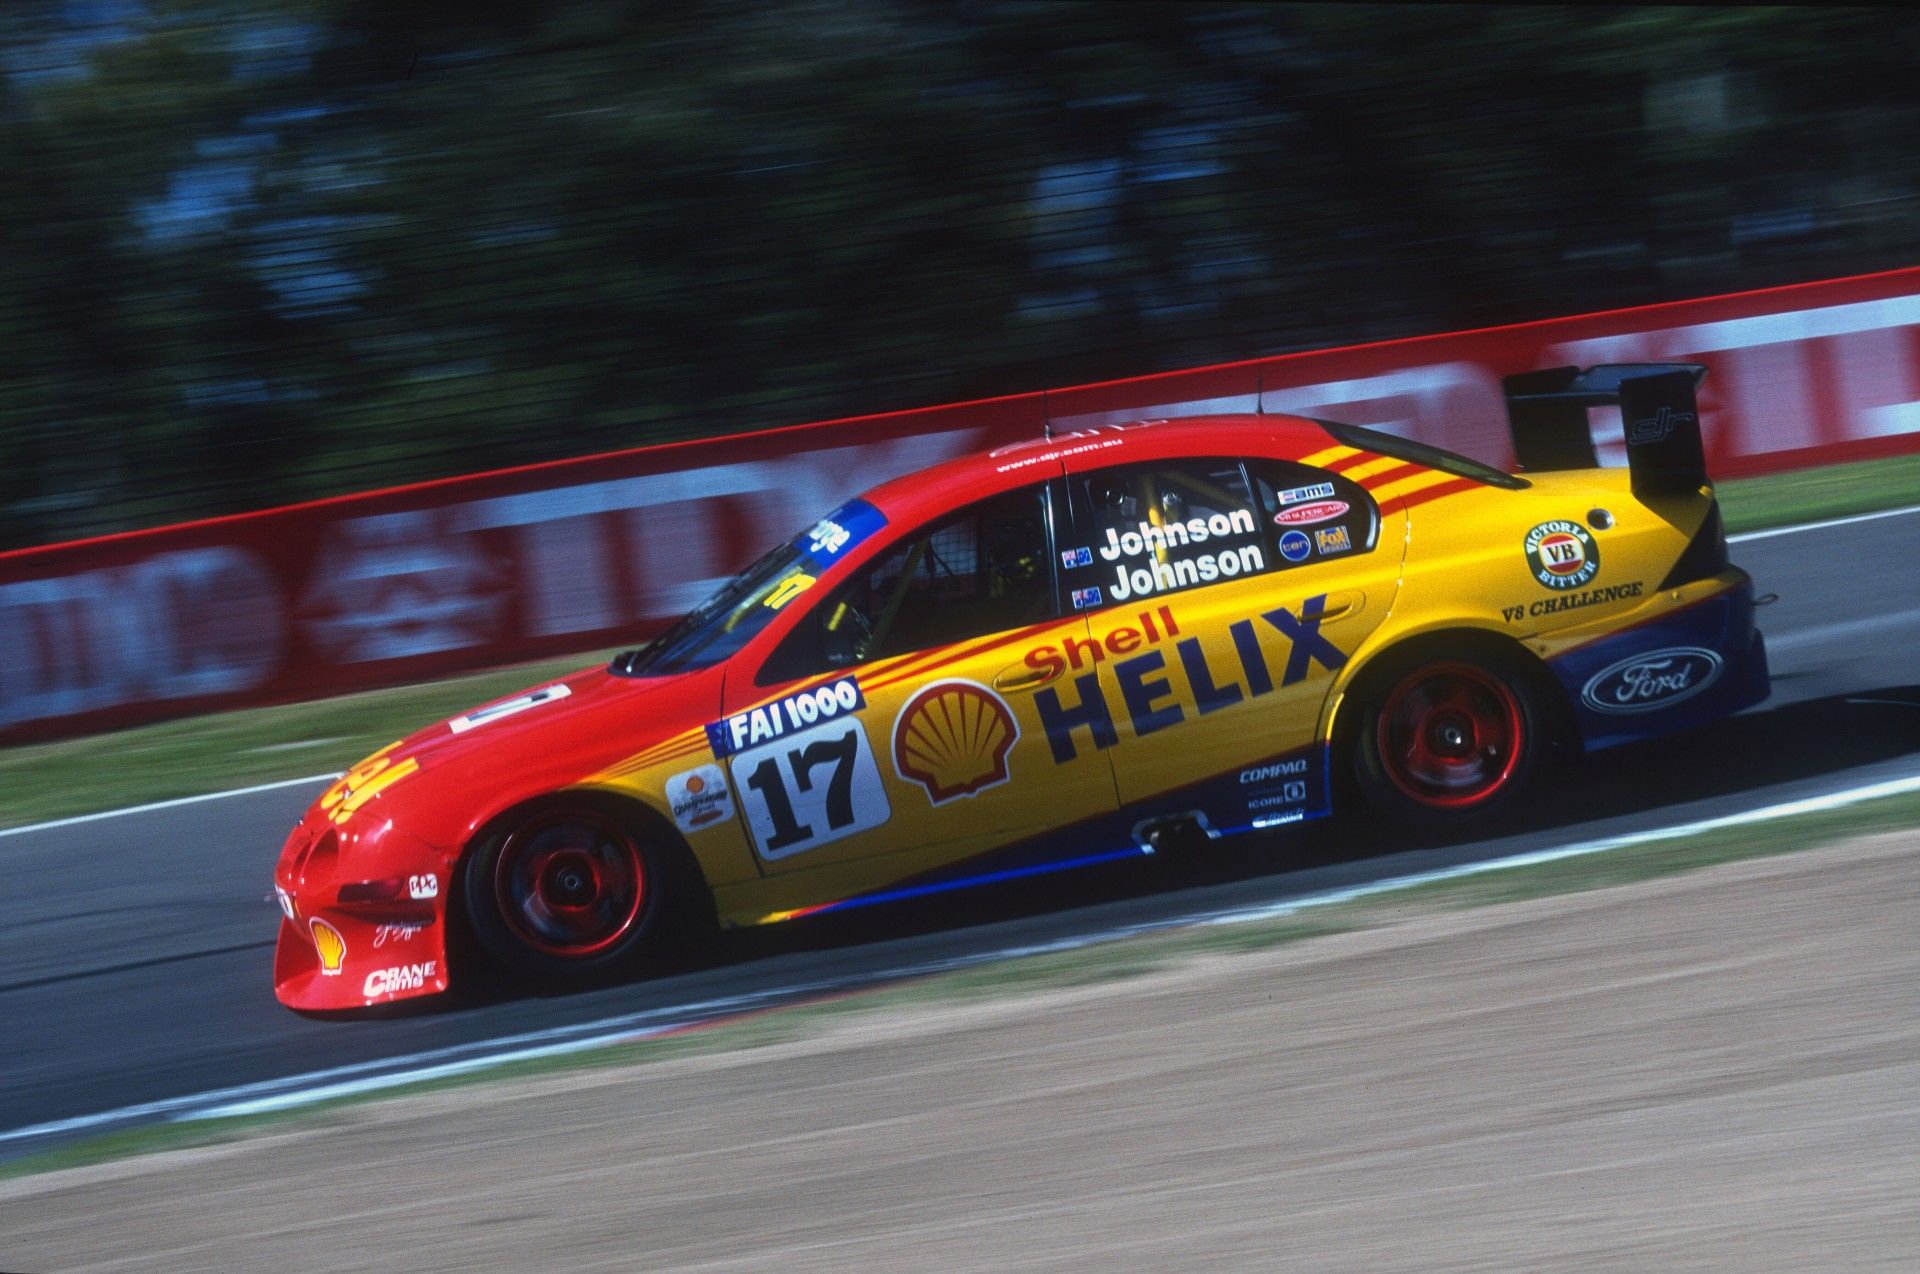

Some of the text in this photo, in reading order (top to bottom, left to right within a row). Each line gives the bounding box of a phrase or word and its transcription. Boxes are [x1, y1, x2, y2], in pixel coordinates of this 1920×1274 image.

[1100, 508, 1255, 561] Johnson
[1526, 520, 1589, 554] VICTORIA
[1546, 543, 1576, 564] VB
[1110, 544, 1265, 600] Johnson
[1538, 560, 1597, 587] BITTER
[1502, 580, 1644, 623] V8 CHALLENGE
[1024, 605, 1180, 683] Shell
[1033, 593, 1349, 765] HELIX
[1615, 659, 1693, 701] Ford
[729, 680, 857, 750] FAI 1000
[747, 729, 858, 851] 17
[1239, 759, 1308, 784] COMPAQ
